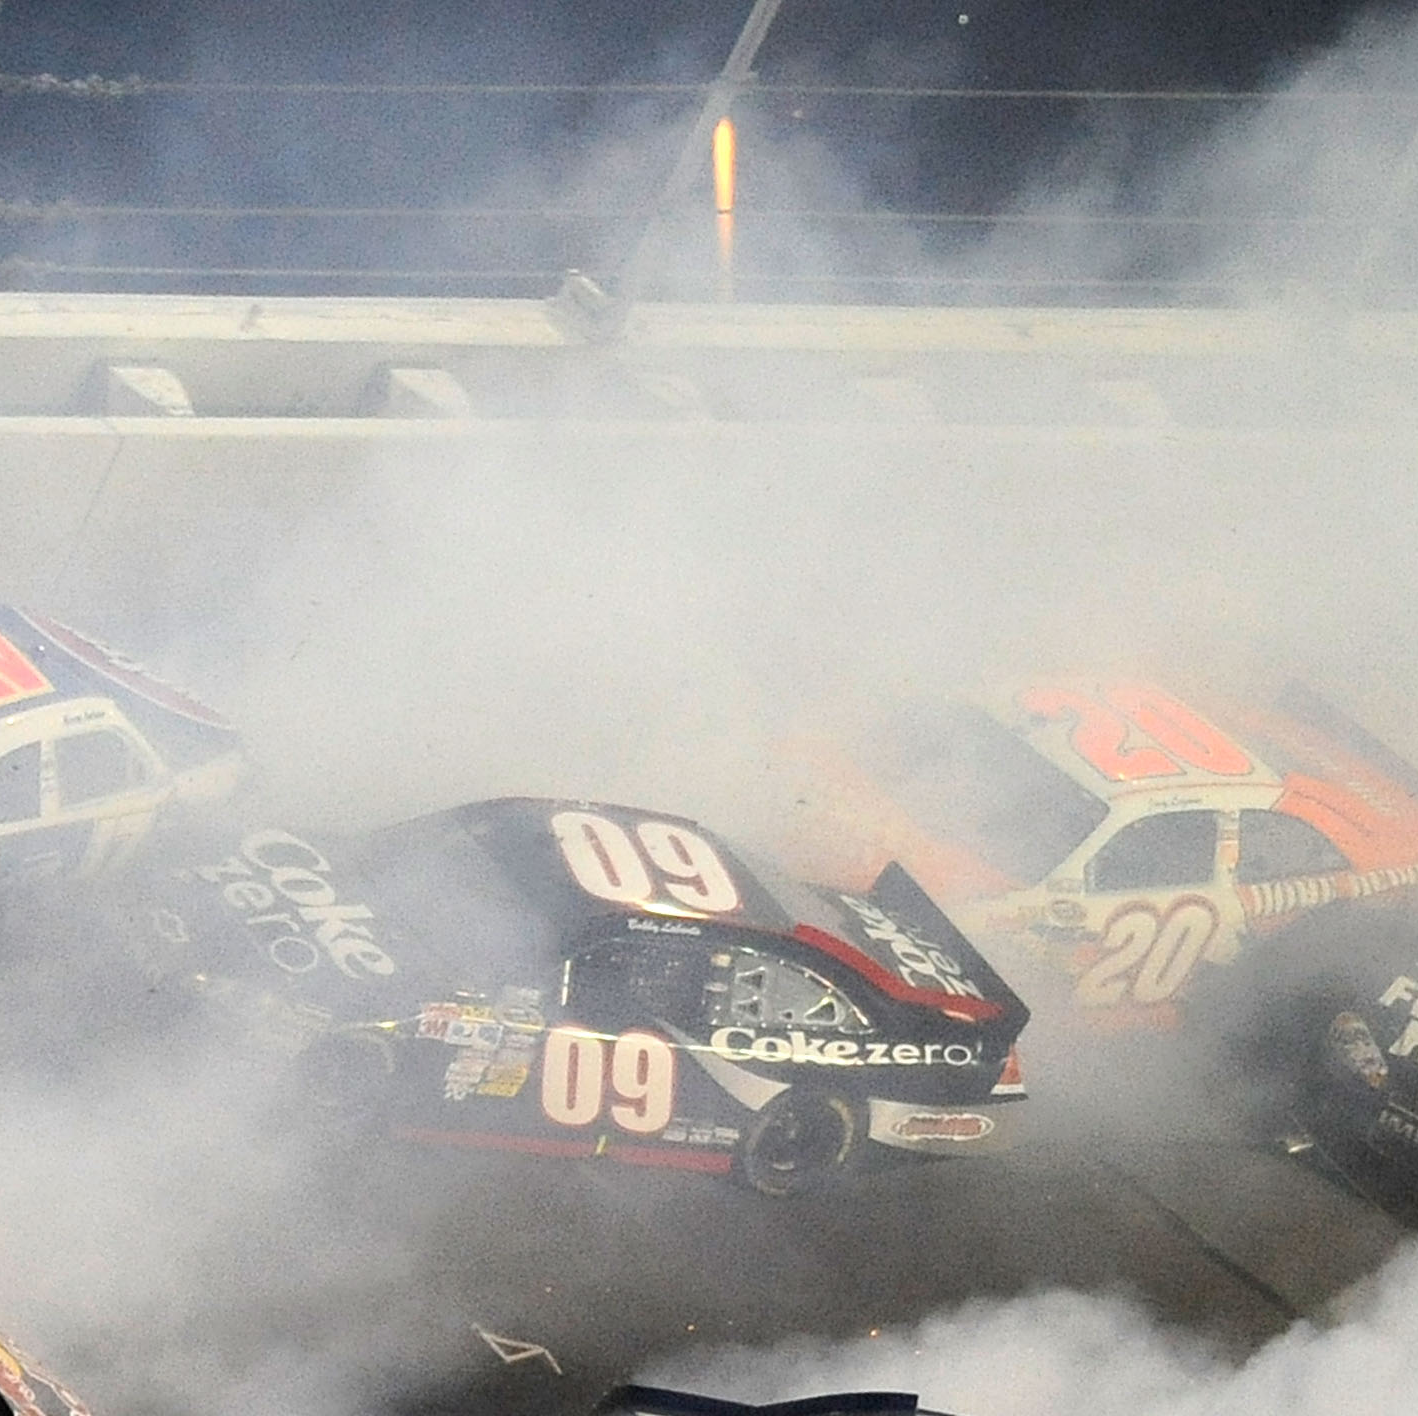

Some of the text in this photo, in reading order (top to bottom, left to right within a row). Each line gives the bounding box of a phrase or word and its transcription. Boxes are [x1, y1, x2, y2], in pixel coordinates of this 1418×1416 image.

[1021, 685, 1253, 781] 20
[242, 829, 395, 980] Coke
[551, 811, 739, 912] 09
[1079, 893, 1220, 1001] 20
[542, 1023, 676, 1133] 09
[711, 1027, 973, 1066] Coke zero
